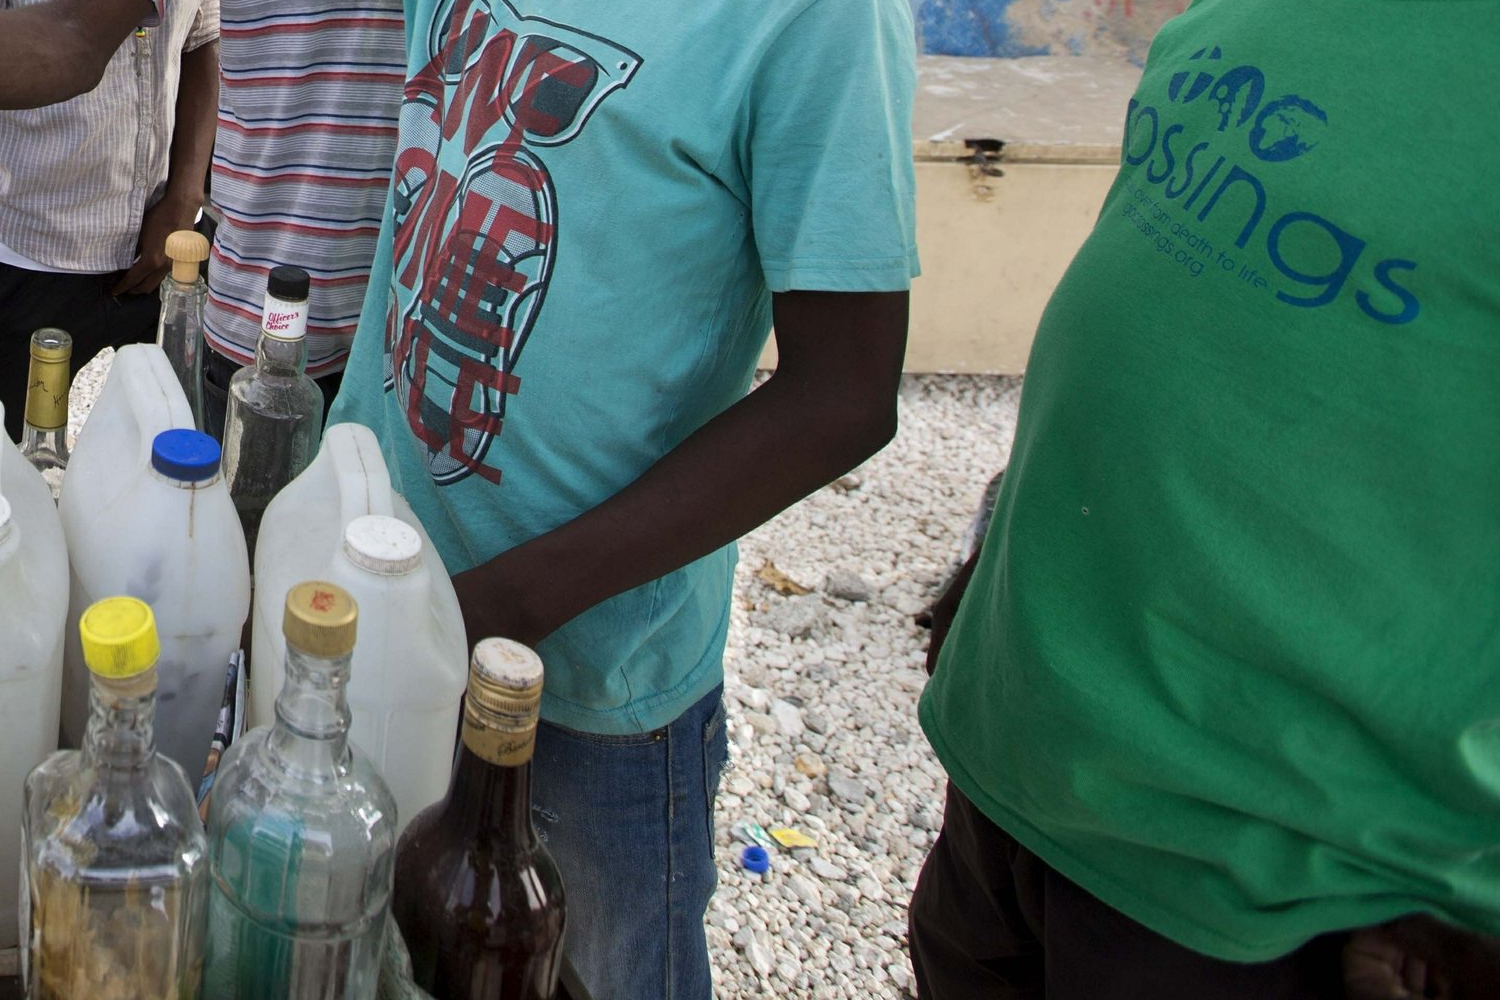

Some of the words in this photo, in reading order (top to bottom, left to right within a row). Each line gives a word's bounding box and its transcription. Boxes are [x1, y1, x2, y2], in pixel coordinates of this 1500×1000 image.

[1126, 97, 1421, 325] ossings
[1170, 222, 1214, 258] death
[1216, 251, 1235, 271] to
[1237, 264, 1268, 288] life
